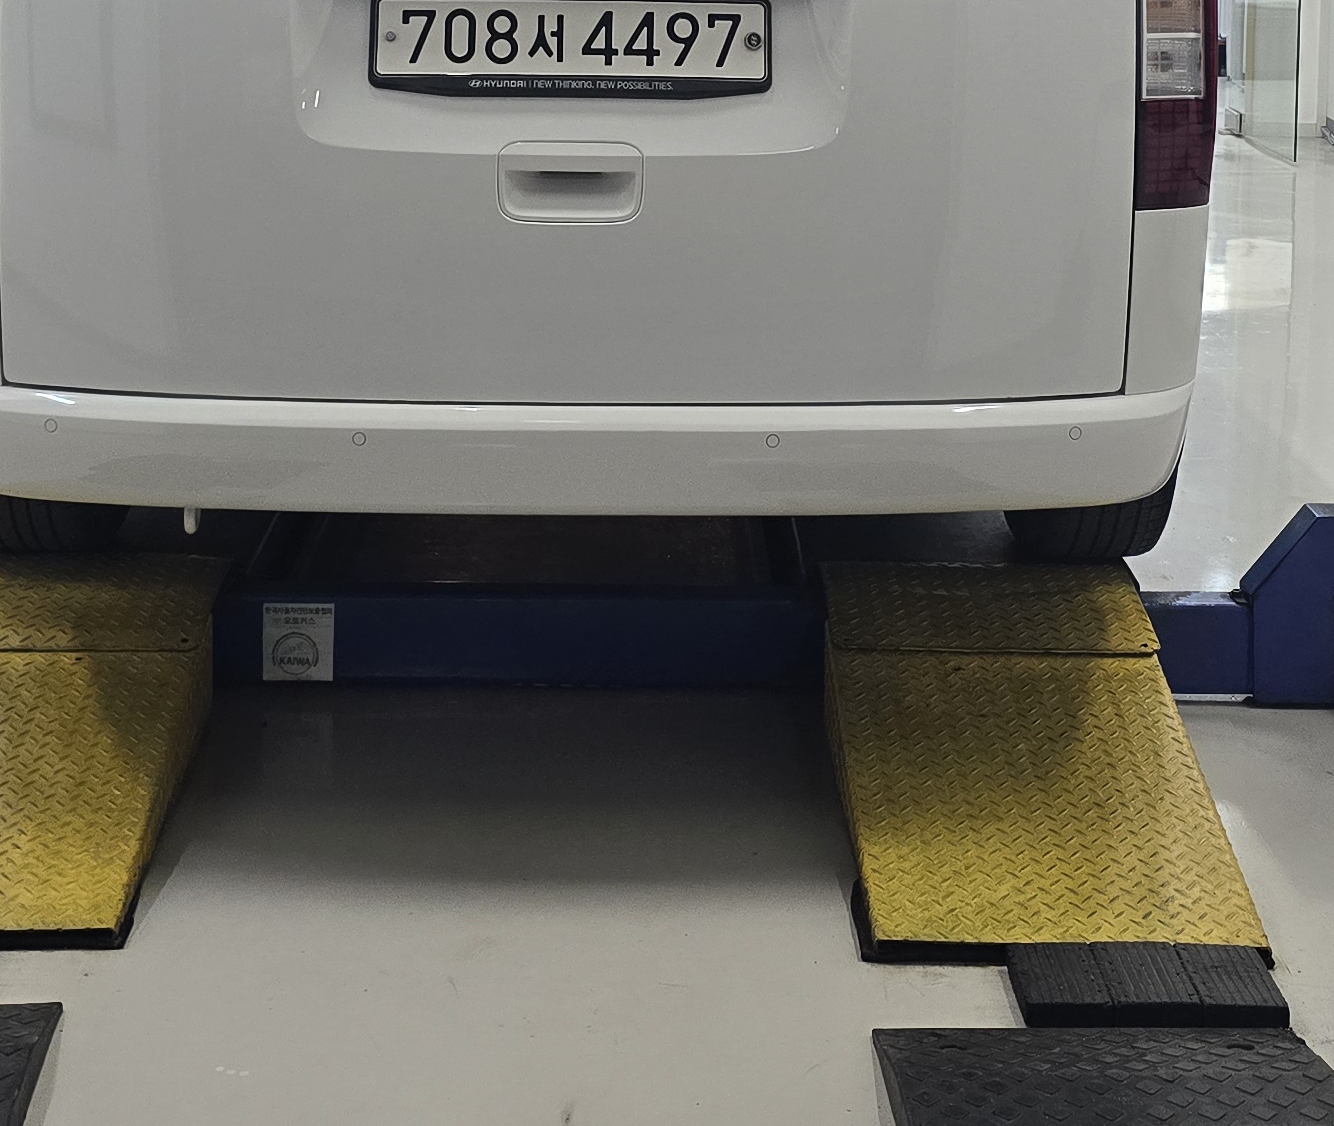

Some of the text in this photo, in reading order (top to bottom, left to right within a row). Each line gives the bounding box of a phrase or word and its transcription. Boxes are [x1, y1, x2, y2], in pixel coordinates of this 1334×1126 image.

[402, 8, 742, 67] 708서 4497
[483, 80, 526, 88] HYUNDAI
[533, 80, 554, 88] NEW
[596, 80, 616, 89] NEW
[279, 656, 311, 666] KAIWA
